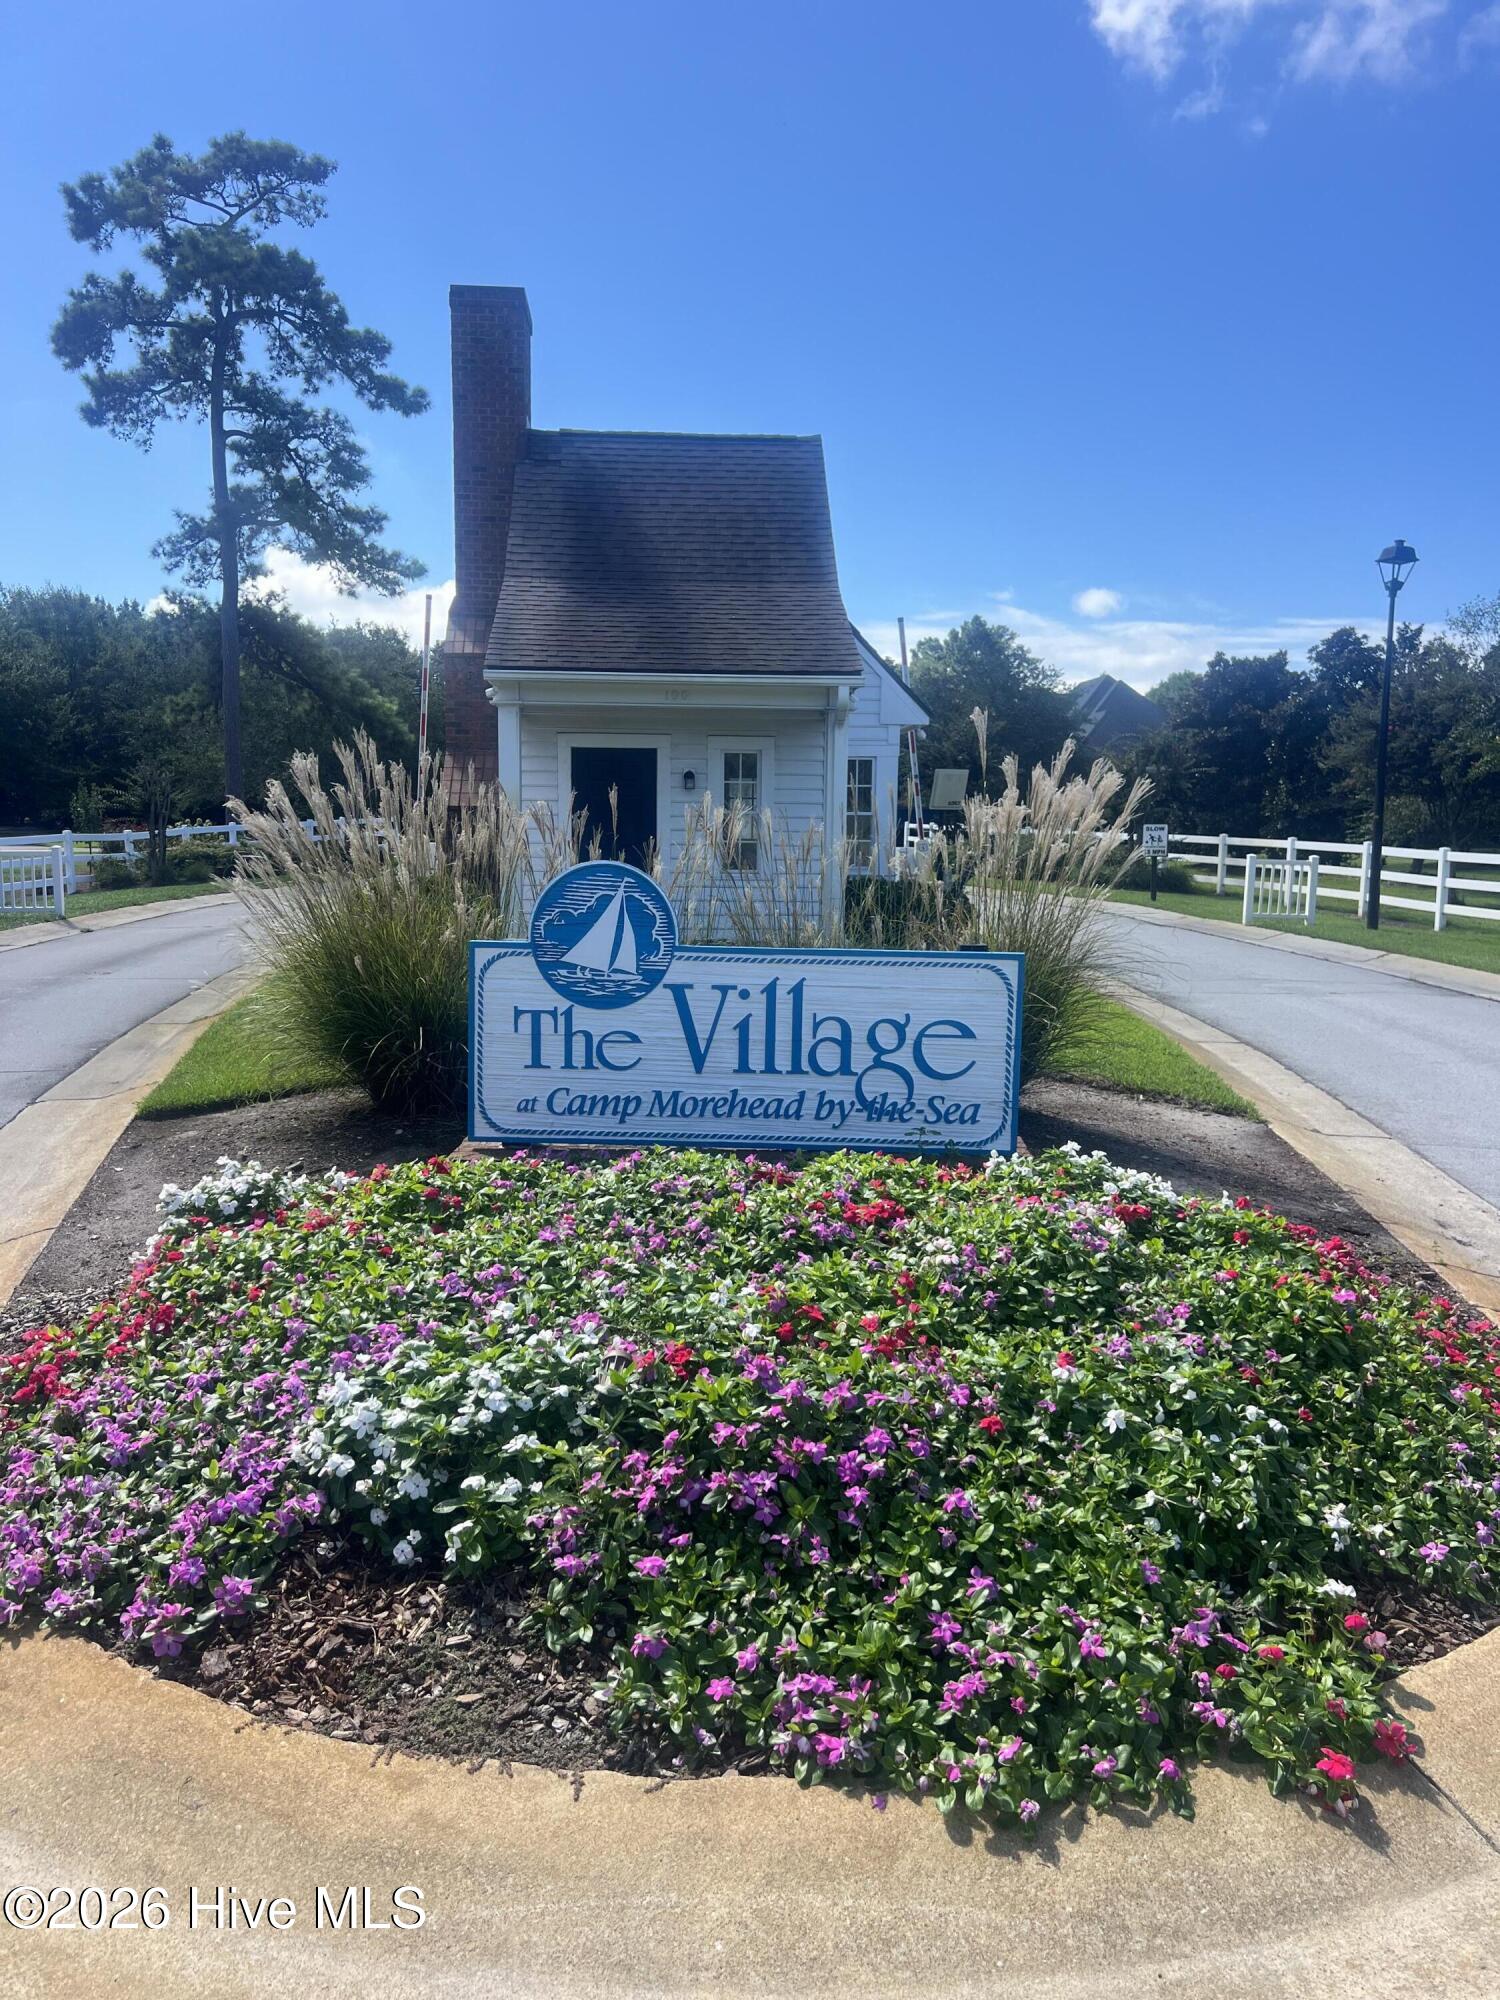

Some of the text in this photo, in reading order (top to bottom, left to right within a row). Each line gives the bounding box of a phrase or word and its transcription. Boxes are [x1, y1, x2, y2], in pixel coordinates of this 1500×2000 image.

[513, 977, 977, 1114] The Village
[516, 1087, 981, 1129] at Camp Morehead by-the-Sea
